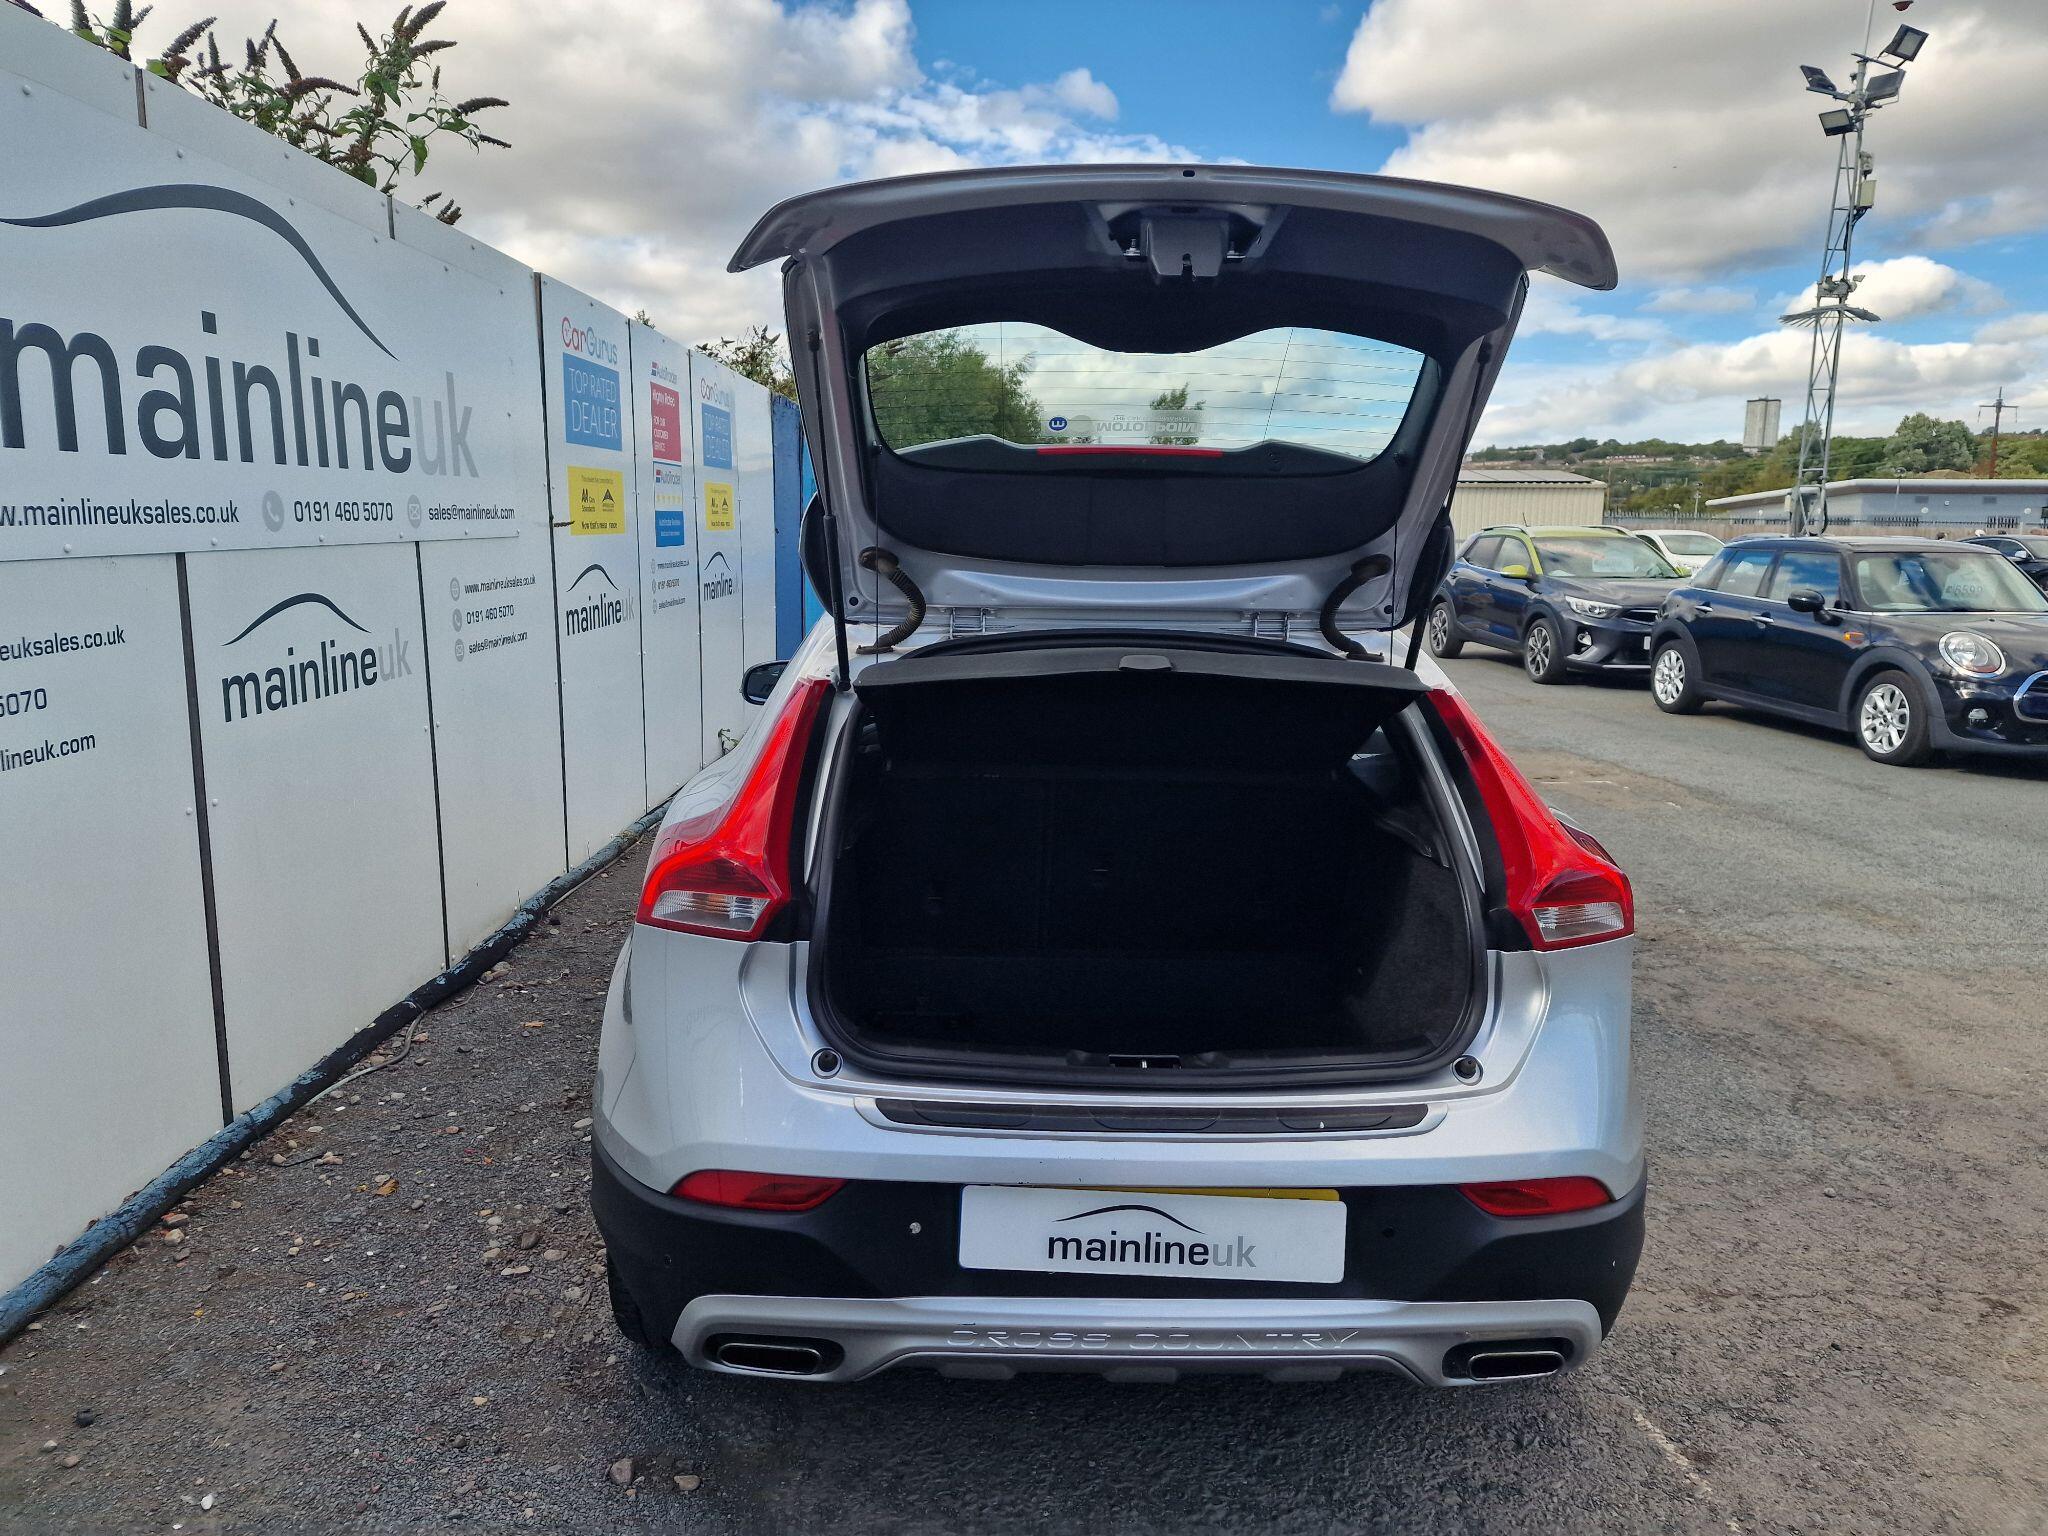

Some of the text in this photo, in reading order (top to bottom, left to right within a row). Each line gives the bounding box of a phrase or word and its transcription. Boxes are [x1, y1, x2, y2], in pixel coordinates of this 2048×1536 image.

[561, 316, 618, 364] CarGurus
[0, 310, 479, 478] mainlineuk
[568, 367, 617, 403] TOP RATED
[571, 399, 619, 438] DEALER
[293, 500, 394, 522] 0191 460 5070
[428, 503, 516, 521] sales@mainlineuk.com
[466, 604, 515, 625] 0191 460 5070
[566, 587, 635, 636] mainlineuk
[221, 627, 412, 723] mainlineuk
[1048, 1230, 1257, 1268] mainlineuk
[947, 1329, 1359, 1351] CROSS COUNTRY
